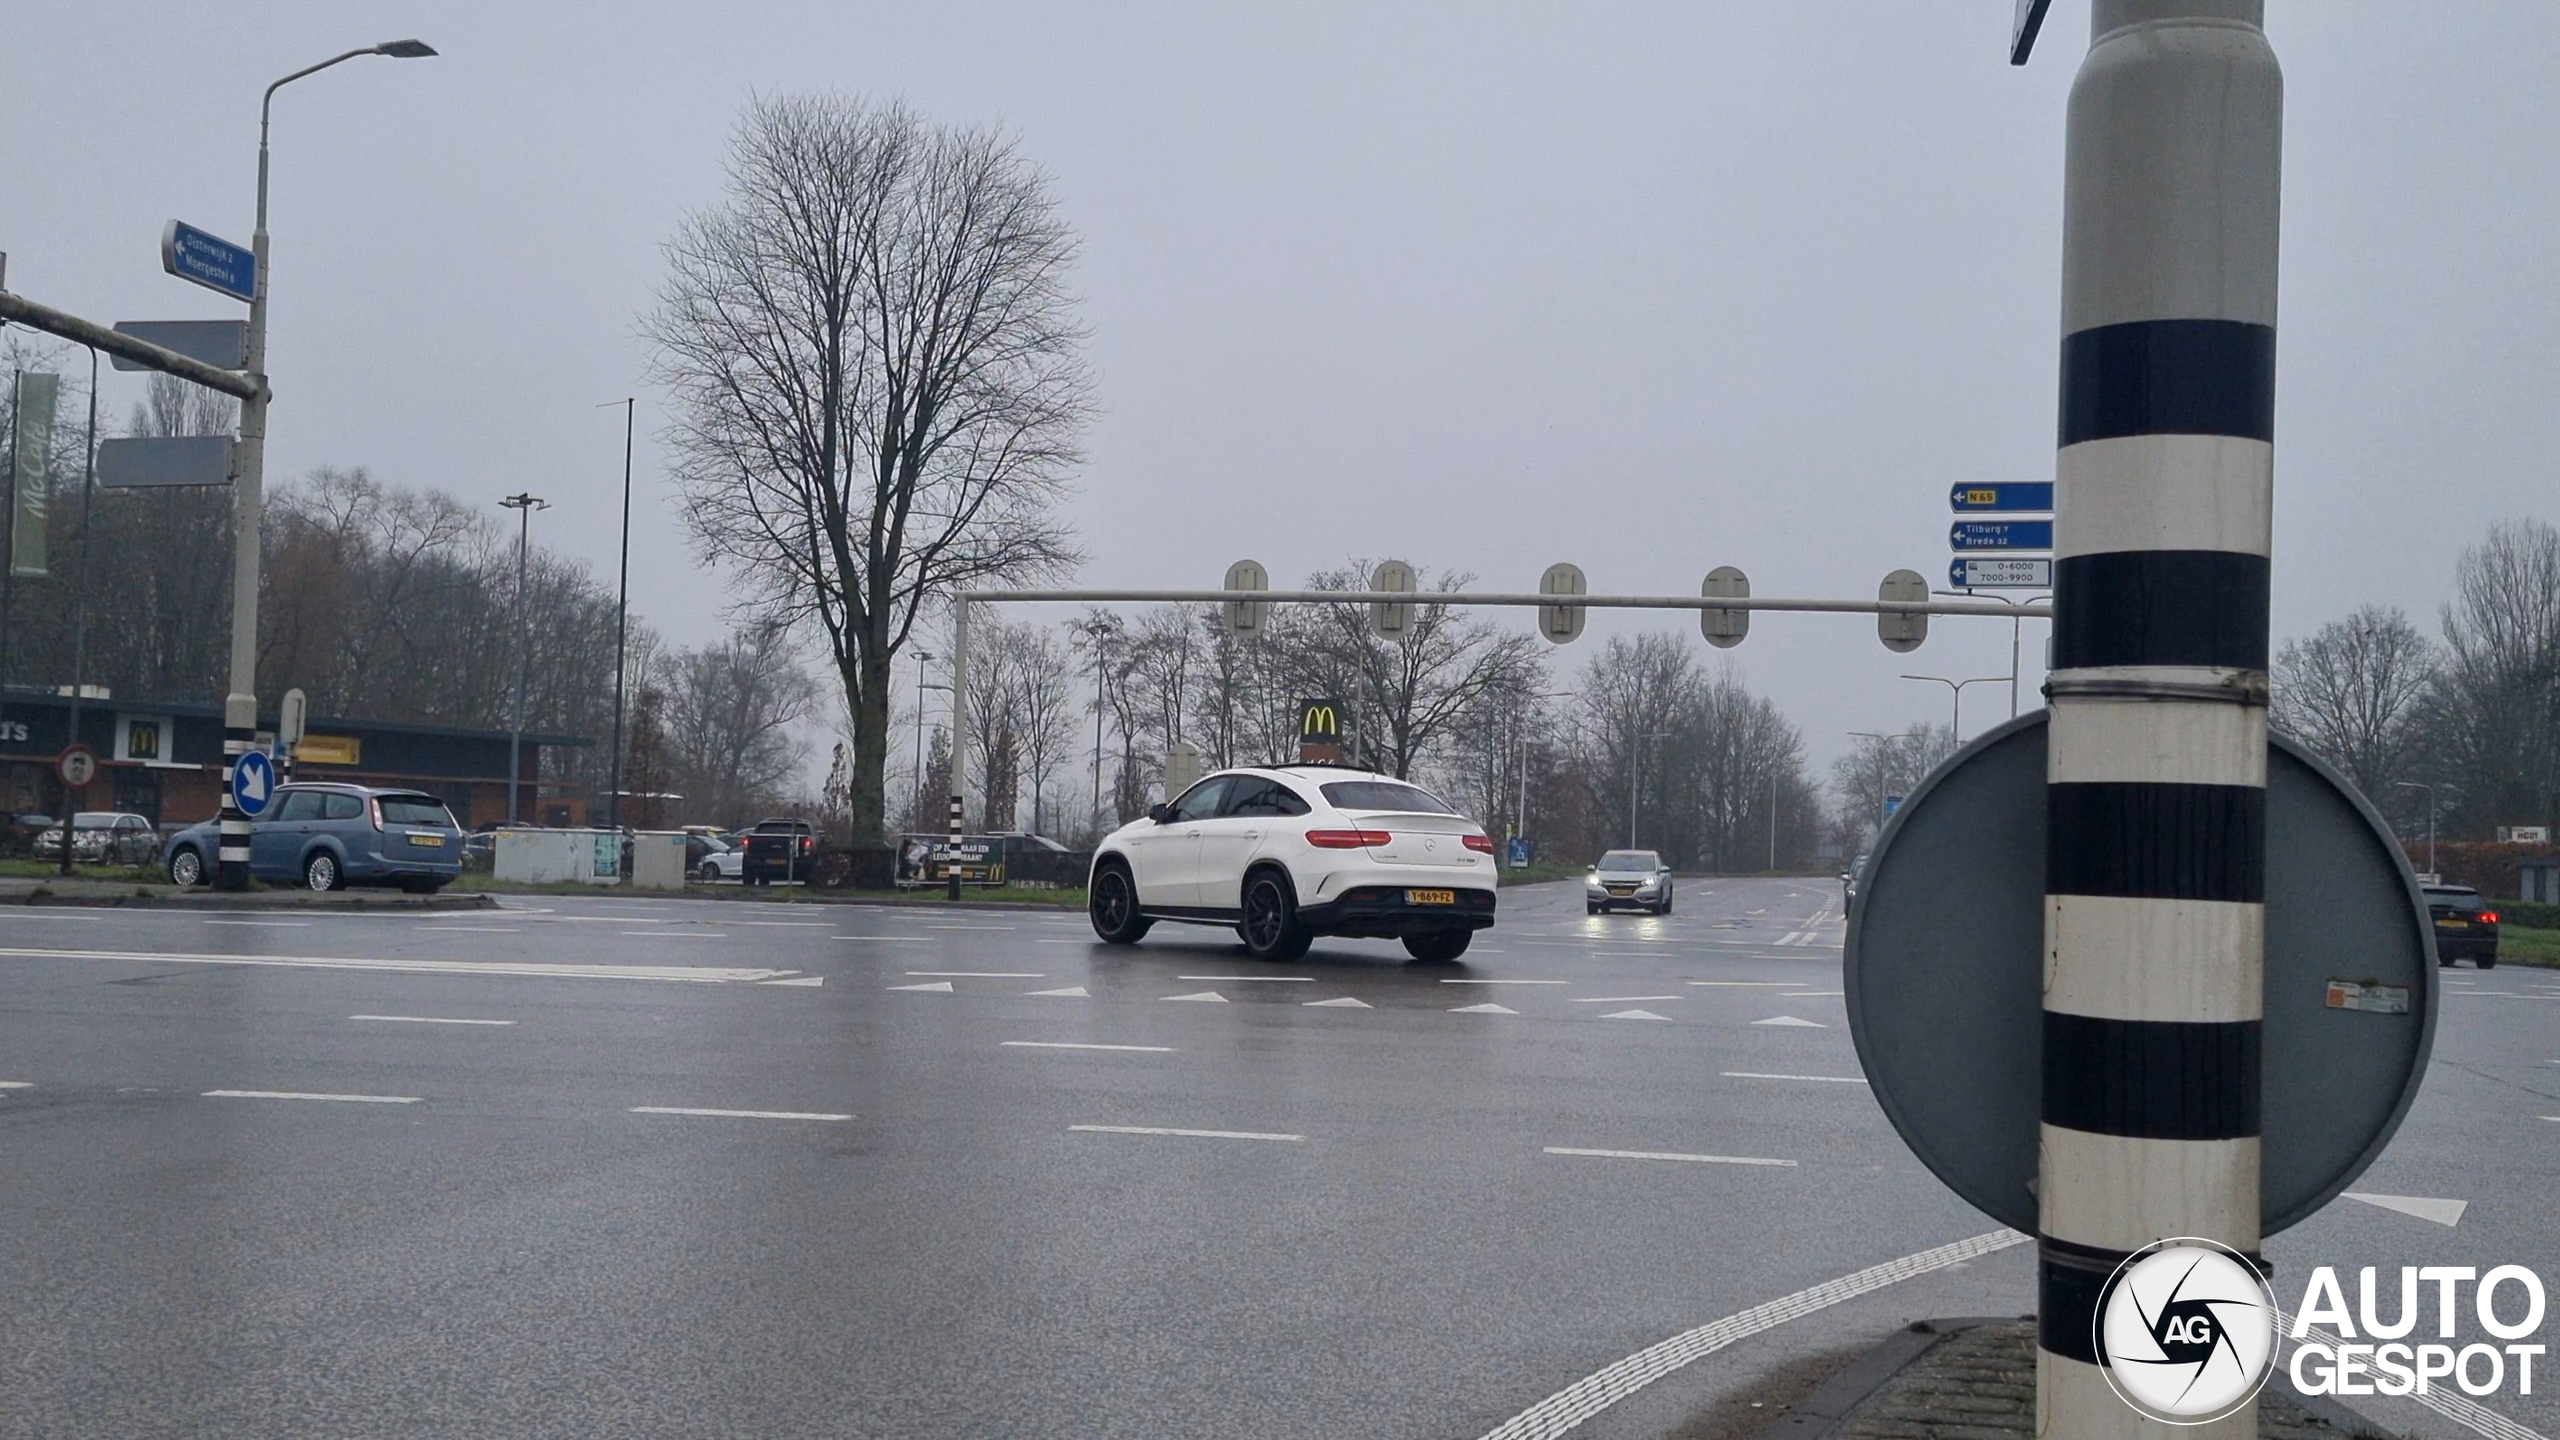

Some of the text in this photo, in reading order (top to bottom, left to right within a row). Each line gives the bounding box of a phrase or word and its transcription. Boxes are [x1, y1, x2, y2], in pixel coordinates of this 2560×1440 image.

[186, 234, 233, 263] Oisterwijk 2
[185, 254, 229, 282] Moergestel
[1966, 525, 2001, 534] Tilburg
[1966, 537, 1994, 545] Breda
[1998, 562, 2034, 570] 0-6000
[1980, 574, 2034, 582] 7000-9900
[933, 843, 943, 852] OP
[978, 845, 990, 853] EEN
[1411, 891, 1452, 902] T-869-FZ
